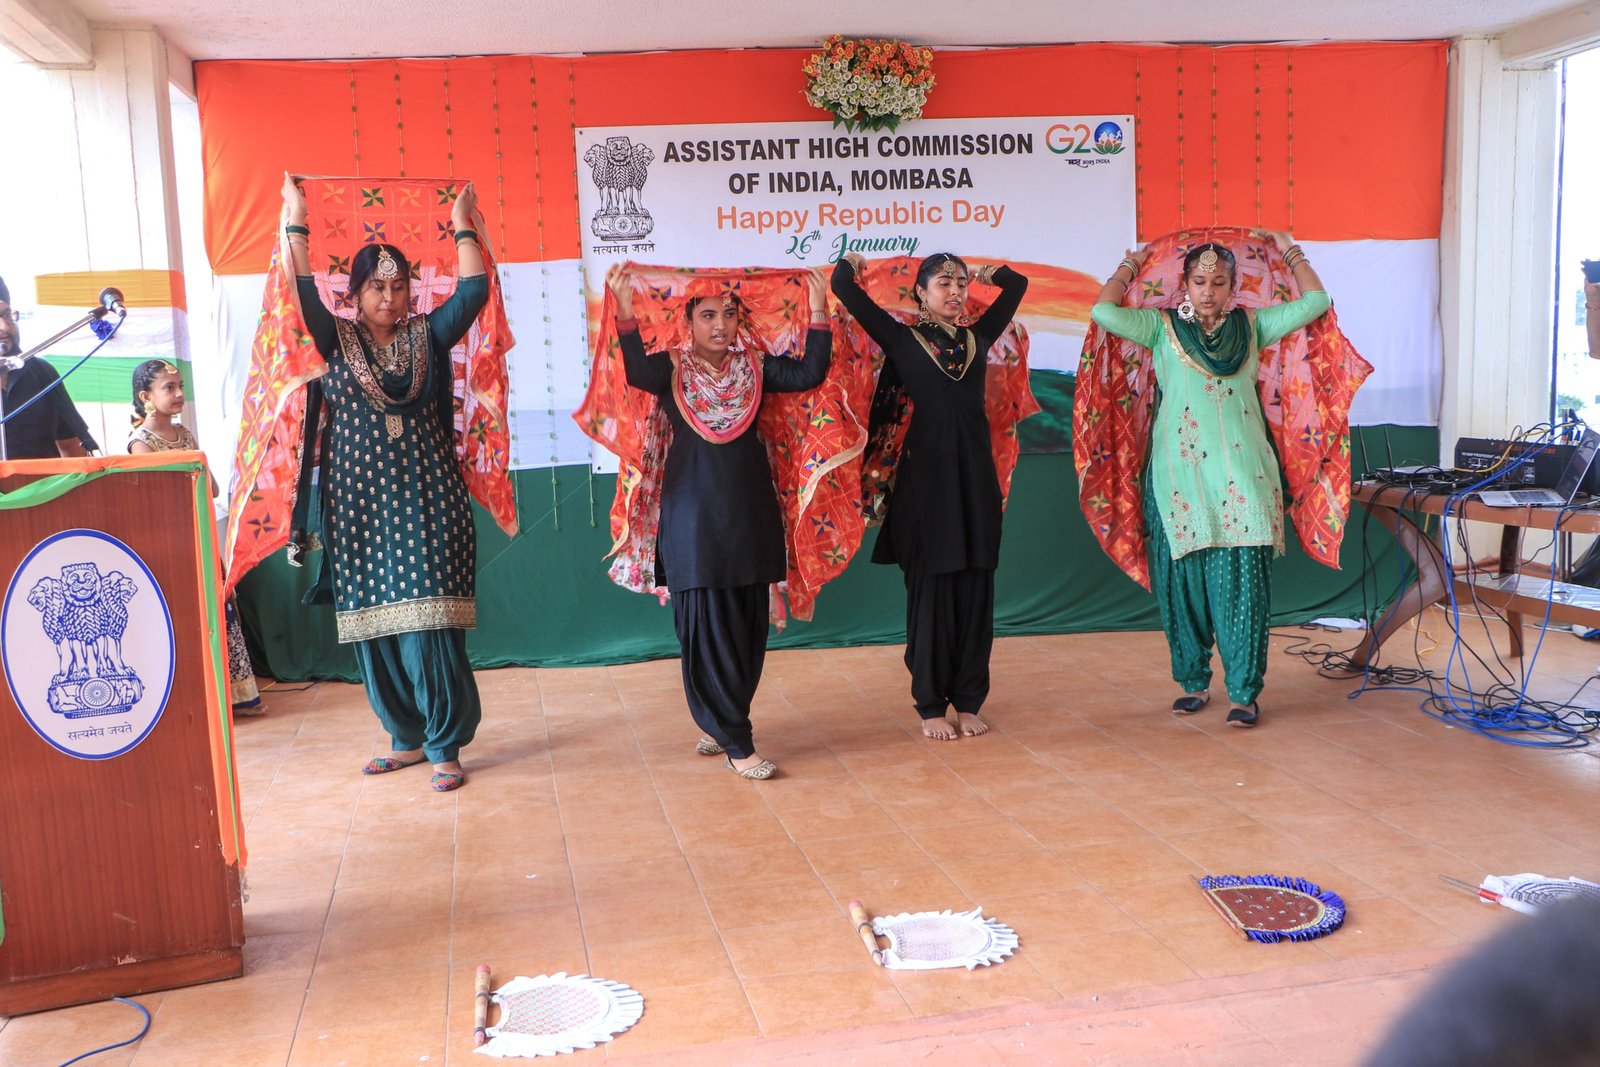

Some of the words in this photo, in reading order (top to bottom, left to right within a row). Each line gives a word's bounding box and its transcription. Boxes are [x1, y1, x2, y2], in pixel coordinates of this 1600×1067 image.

[664, 139, 800, 163] ASSISTANT
[808, 136, 869, 159] HIGH
[877, 133, 1033, 158] COMMISSION
[729, 172, 760, 194] OF
[769, 170, 843, 196] INDIA,
[851, 167, 974, 191] MOMBASA
[717, 203, 809, 234] Happy
[818, 200, 943, 232] Republic
[952, 199, 1006, 228] Day
[593, 241, 628, 255] सत्यमेव
[632, 240, 655, 253] जयते
[828, 232, 920, 264] January
[68, 726, 104, 740] सत्यमेव
[107, 721, 132, 735] जयते
